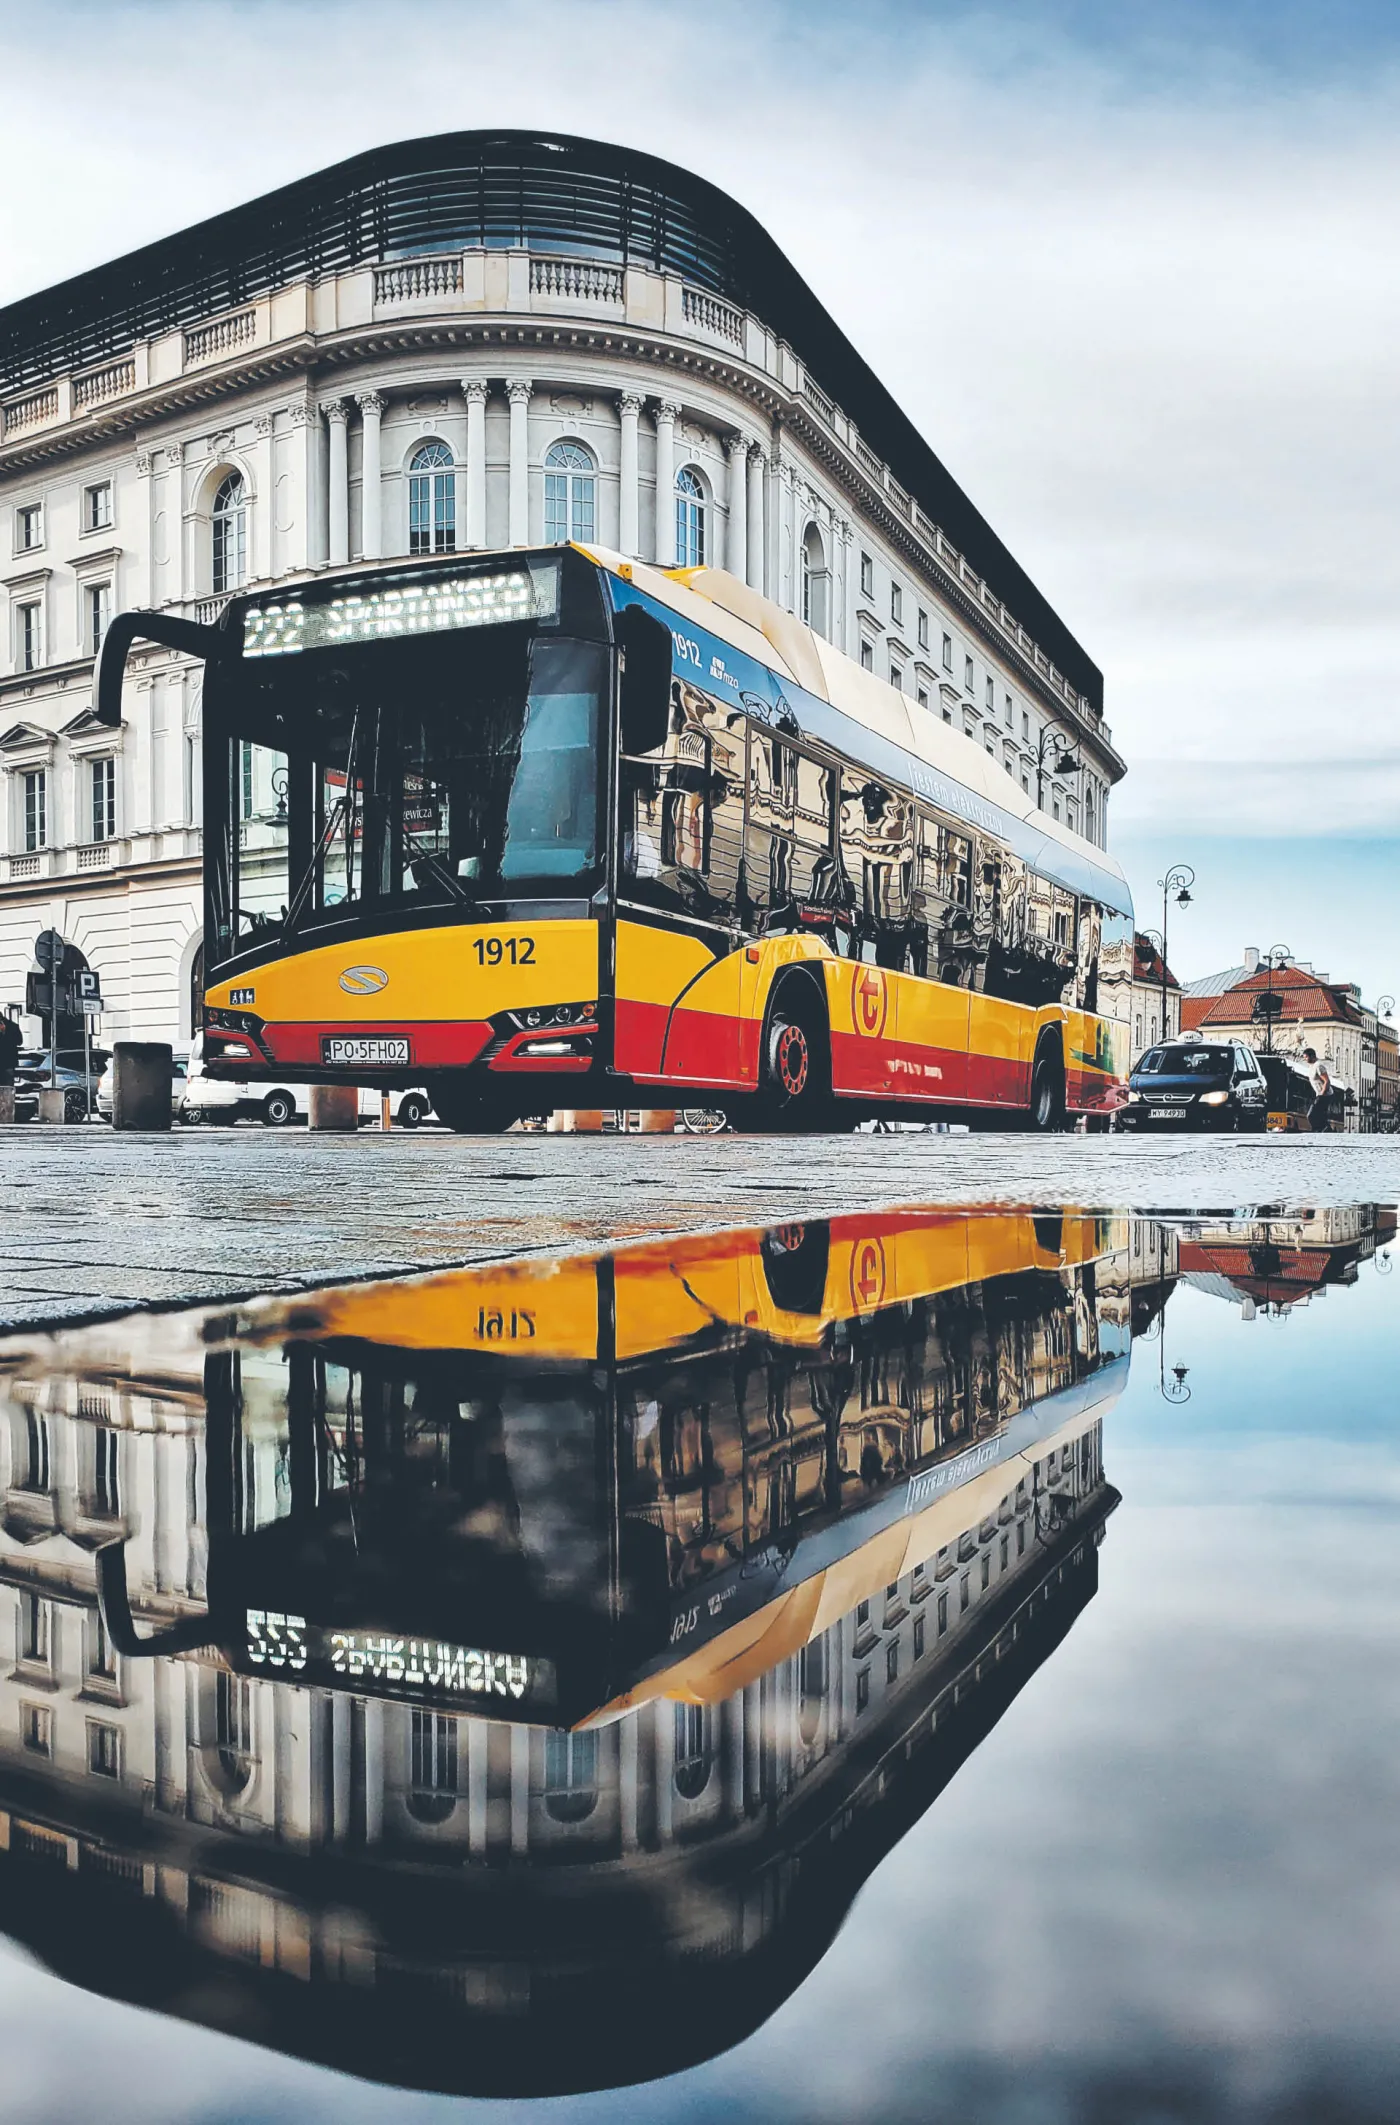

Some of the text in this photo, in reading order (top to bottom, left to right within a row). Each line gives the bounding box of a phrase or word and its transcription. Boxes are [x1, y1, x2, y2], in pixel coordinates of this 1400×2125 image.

[243, 573, 528, 657] 222 SPARTAŃSKA
[672, 631, 703, 668] 1912
[912, 764, 1003, 837] jestem elektryczny
[472, 937, 536, 966] 1912
[80, 974, 95, 997] P
[333, 1041, 354, 1059] PO
[359, 1041, 406, 1059] 5FH02
